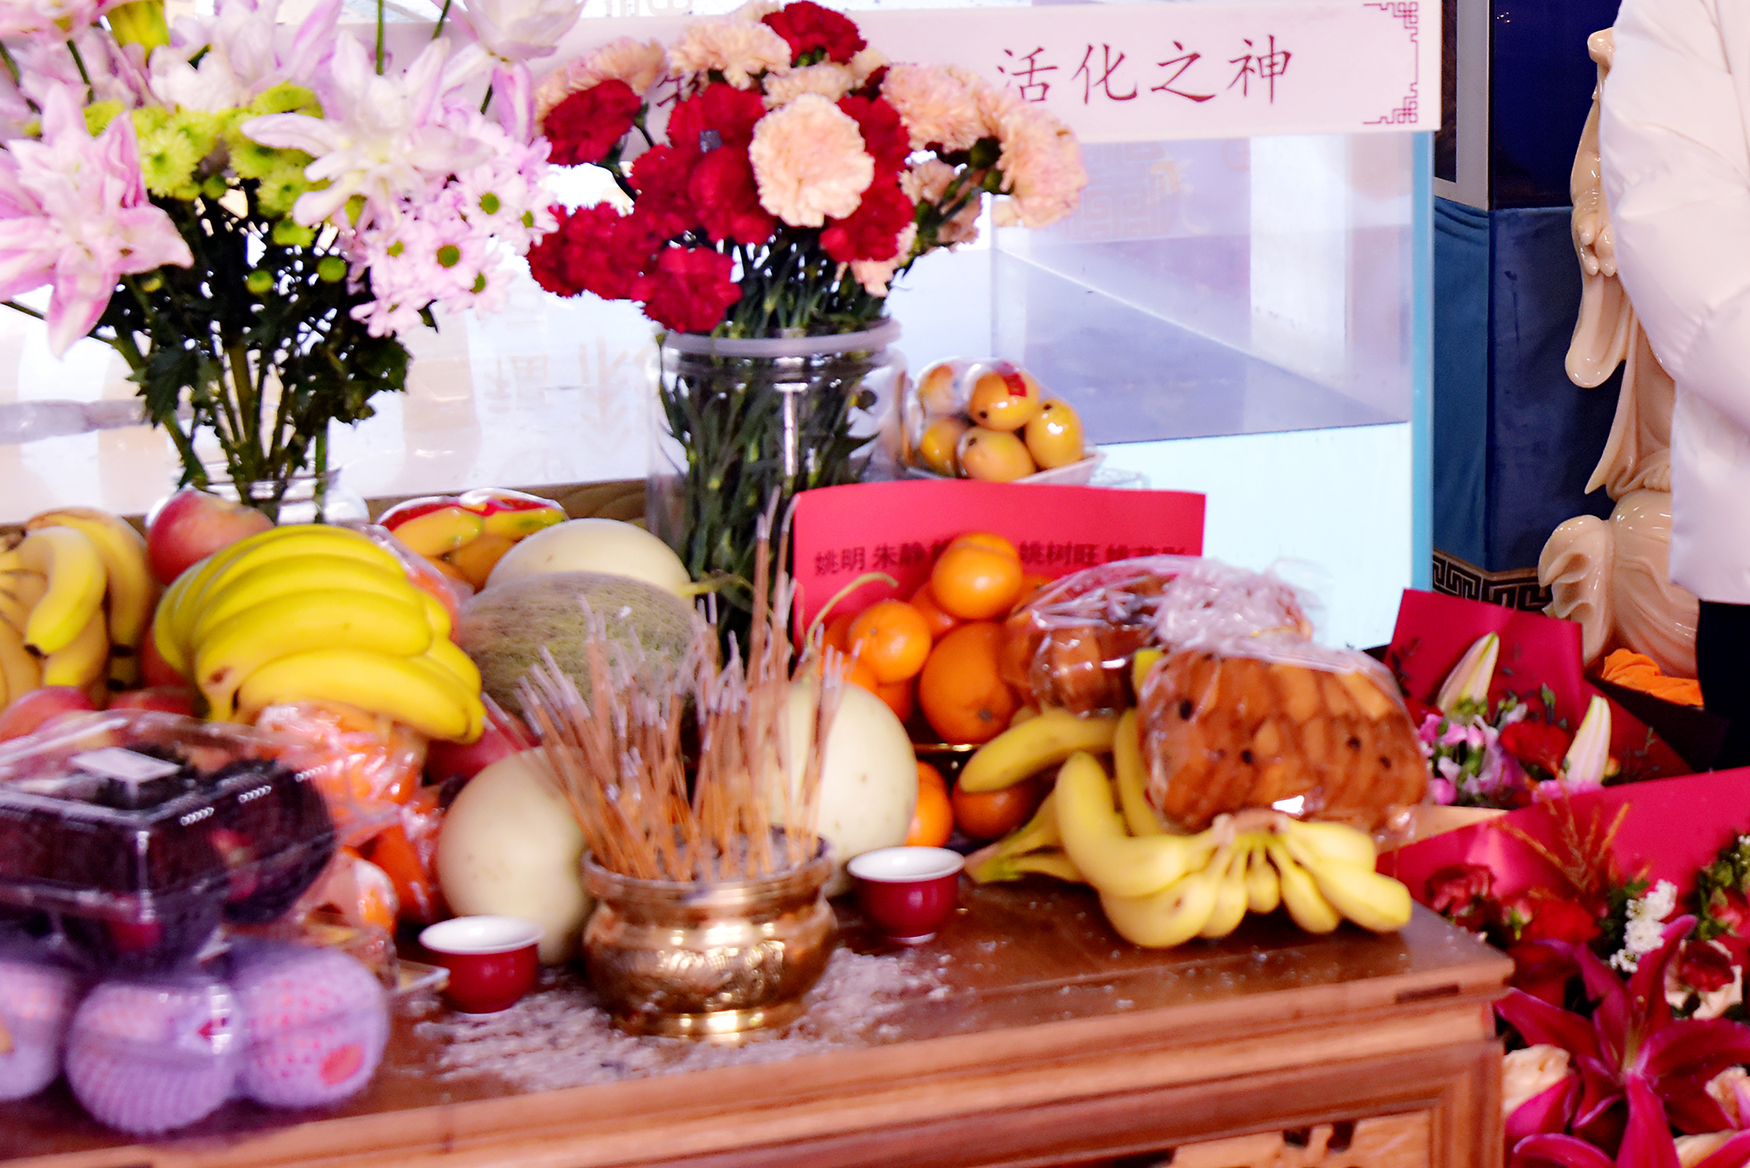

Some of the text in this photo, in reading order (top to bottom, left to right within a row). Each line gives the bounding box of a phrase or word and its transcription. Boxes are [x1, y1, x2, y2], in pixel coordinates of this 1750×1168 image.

[997, 34, 1293, 105] 活化之神
[815, 545, 866, 575] 姚明
